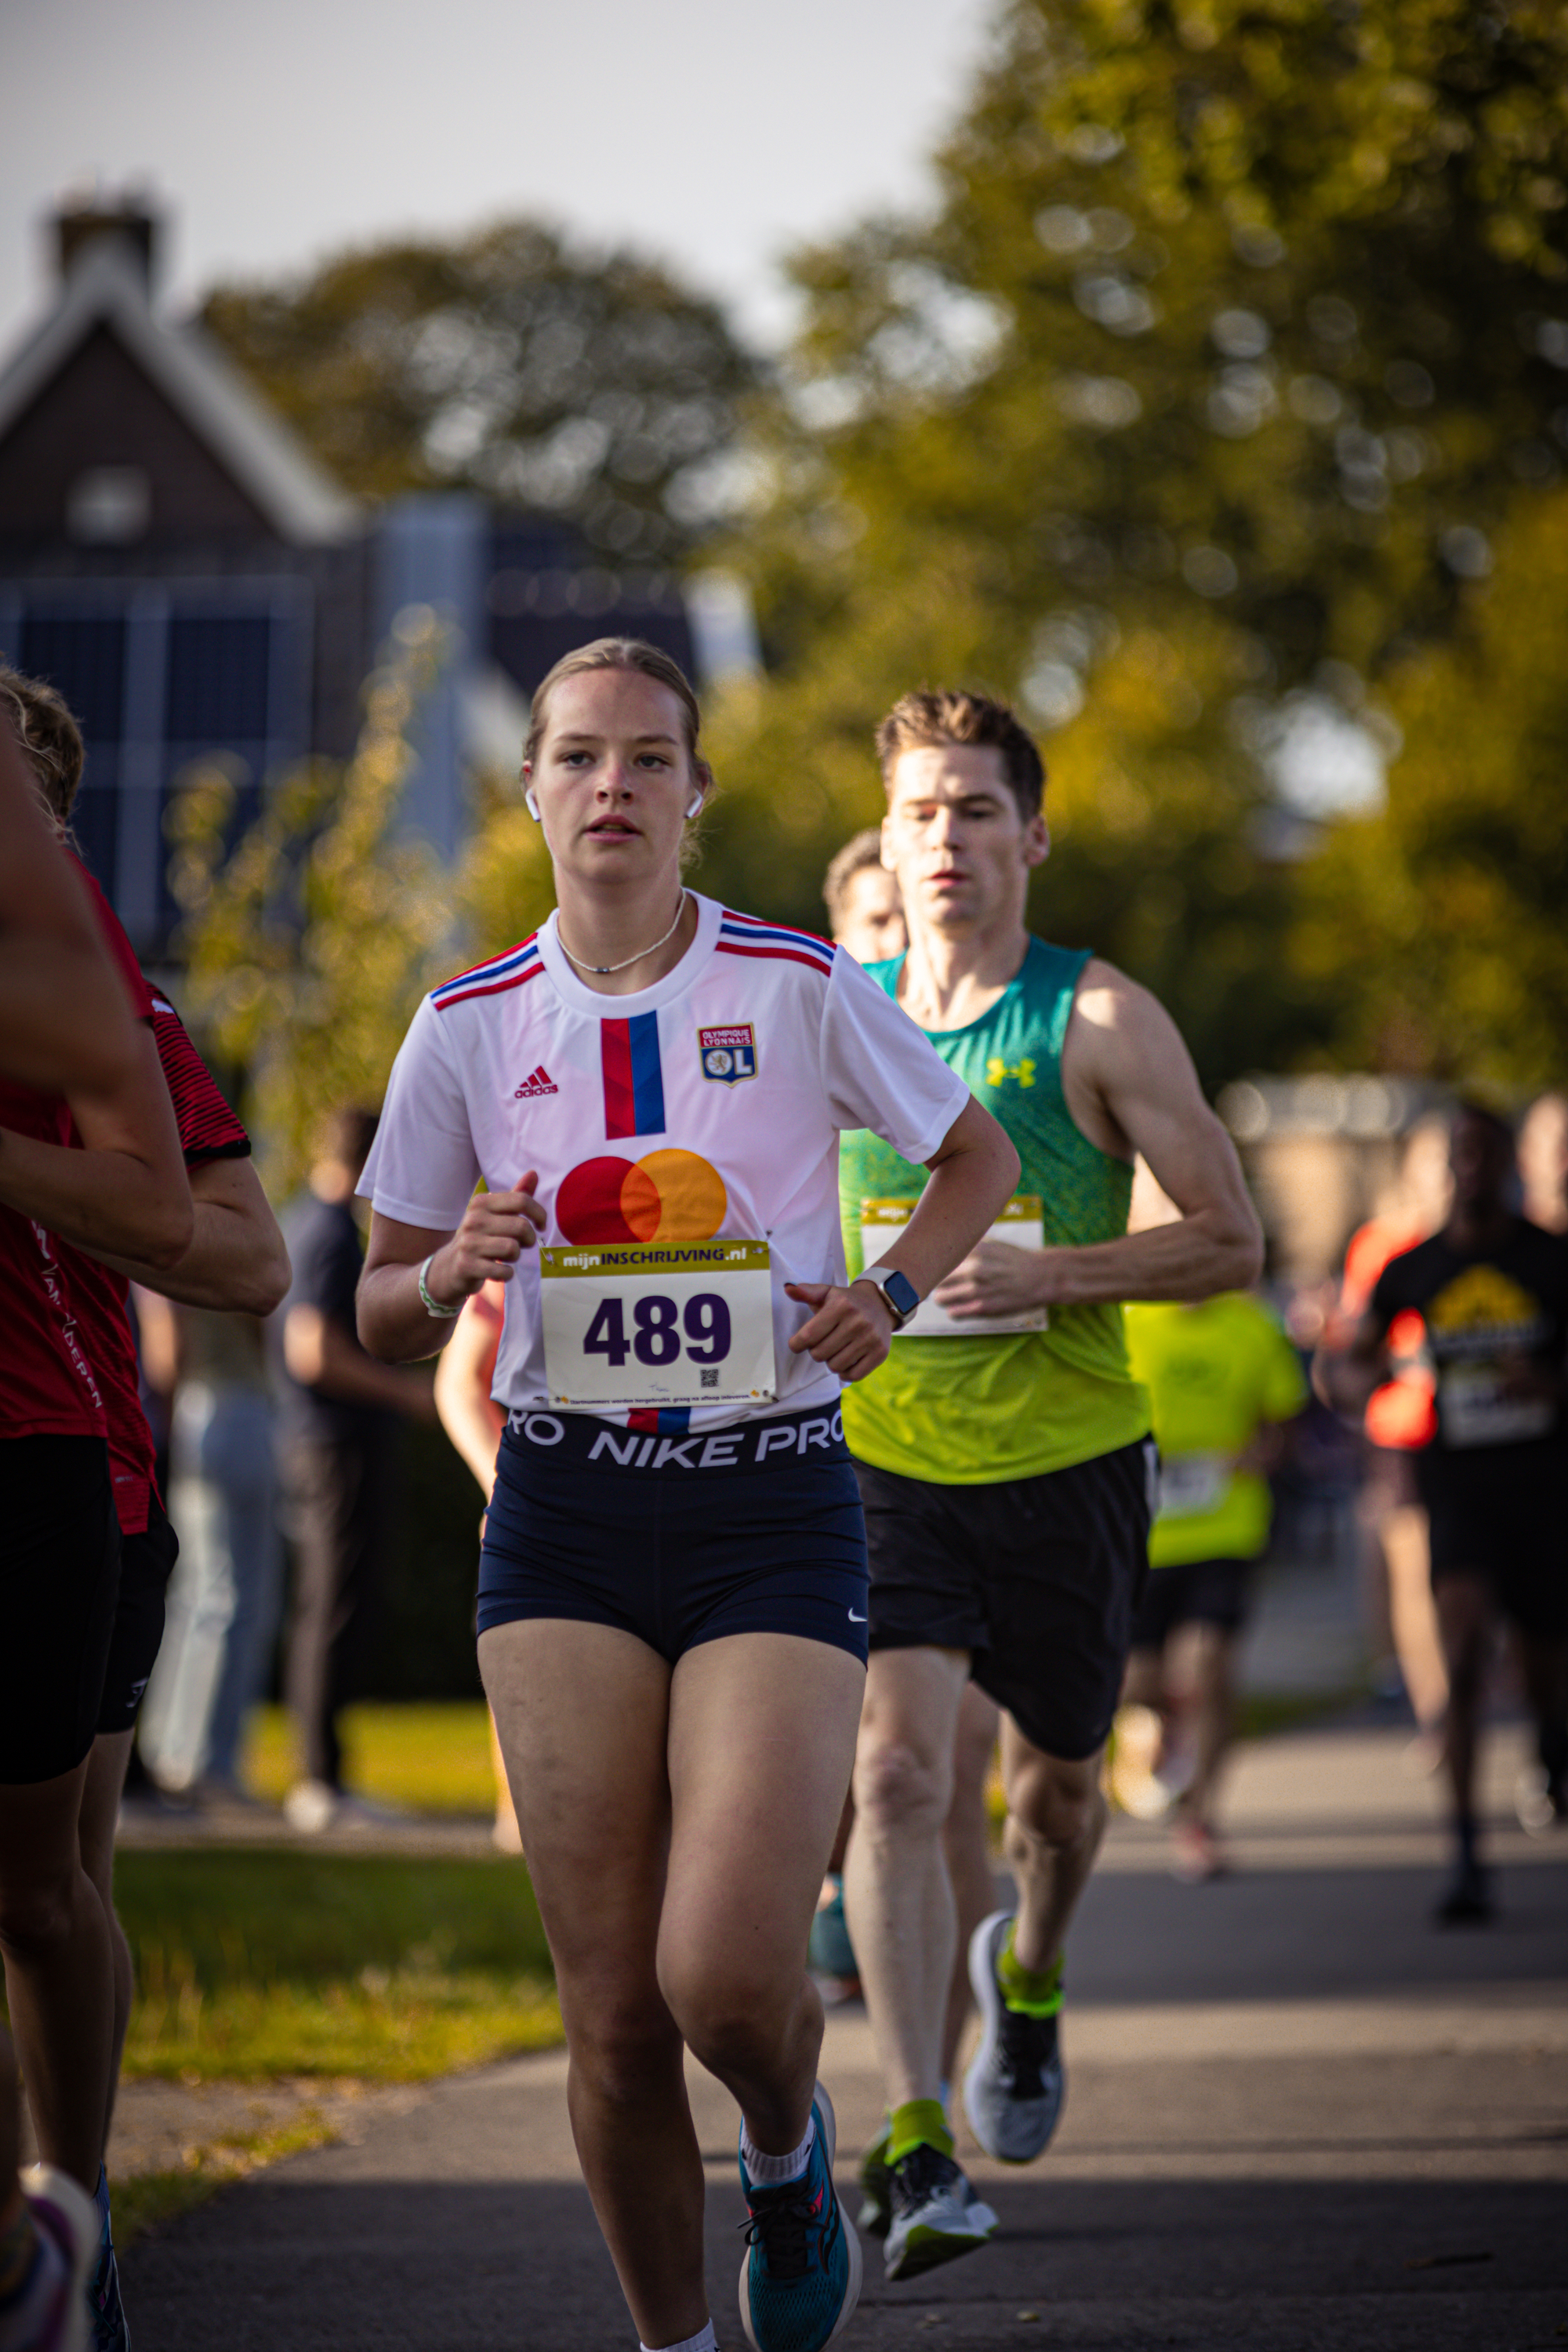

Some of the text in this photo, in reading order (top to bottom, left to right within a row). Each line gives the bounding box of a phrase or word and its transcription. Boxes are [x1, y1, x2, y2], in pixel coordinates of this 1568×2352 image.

[702, 1029, 750, 1040] OLYMPIQUE
[703, 1036, 751, 1047] LYONNAIS
[706, 1049, 752, 1075] OL
[514, 1084, 558, 1099] adidas
[583, 1293, 731, 1367] 489
[587, 1432, 745, 1468] NIKE
[755, 1410, 844, 1462] PRO
